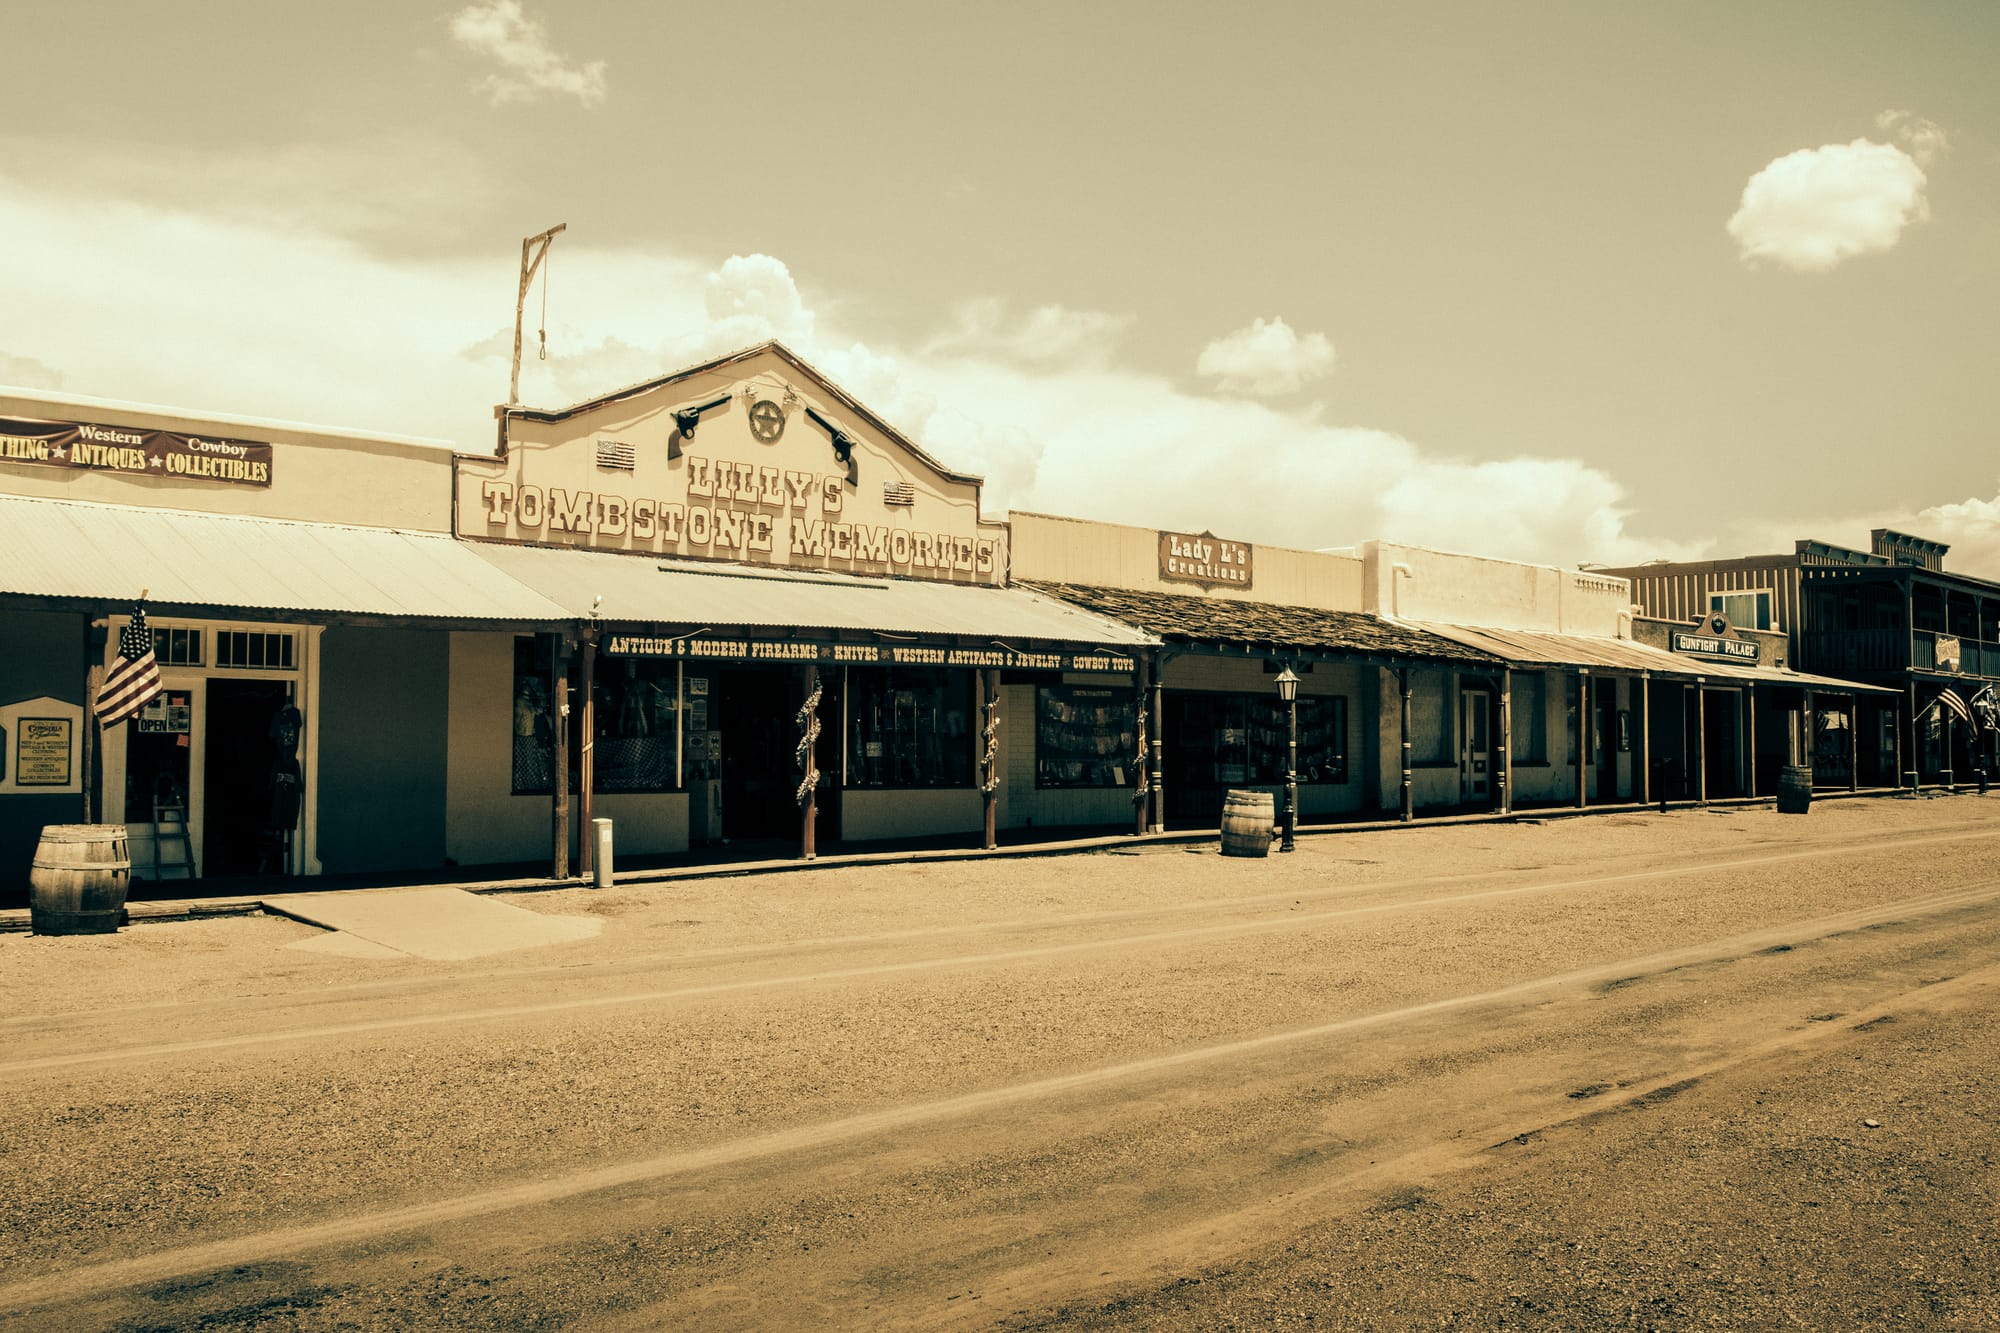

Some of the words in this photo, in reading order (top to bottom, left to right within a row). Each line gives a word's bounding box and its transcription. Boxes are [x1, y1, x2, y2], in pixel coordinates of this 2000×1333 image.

[78, 424, 143, 445] Western
[187, 438, 248, 459] Cowboy
[70, 443, 146, 470] ANTIQUES
[165, 452, 268, 482] COLLECTIBLES
[688, 456, 844, 514] LILLY'S
[482, 479, 774, 553] TOMBSTONE
[790, 516, 995, 574] MEMORIES
[1170, 535, 1213, 564] Lady
[1220, 543, 1246, 565] L's
[1168, 557, 1246, 581] Creations
[609, 637, 673, 655] ANTIQUE
[676, 639, 686, 656] &
[690, 640, 748, 657] MODERN
[751, 642, 818, 659] FIREARMS
[834, 645, 879, 662] KNIVES
[893, 647, 945, 665] WESTERN
[948, 650, 1004, 666] ARTIFACTS
[1006, 652, 1013, 666] &
[1015, 652, 1061, 668] JEWELRY
[1073, 655, 1110, 670] COWBOY
[1112, 657, 1135, 671] TOYS
[1679, 636, 1719, 653] GUNFIGHT
[1725, 641, 1755, 657] PALACE
[140, 719, 167, 731] OPEN
